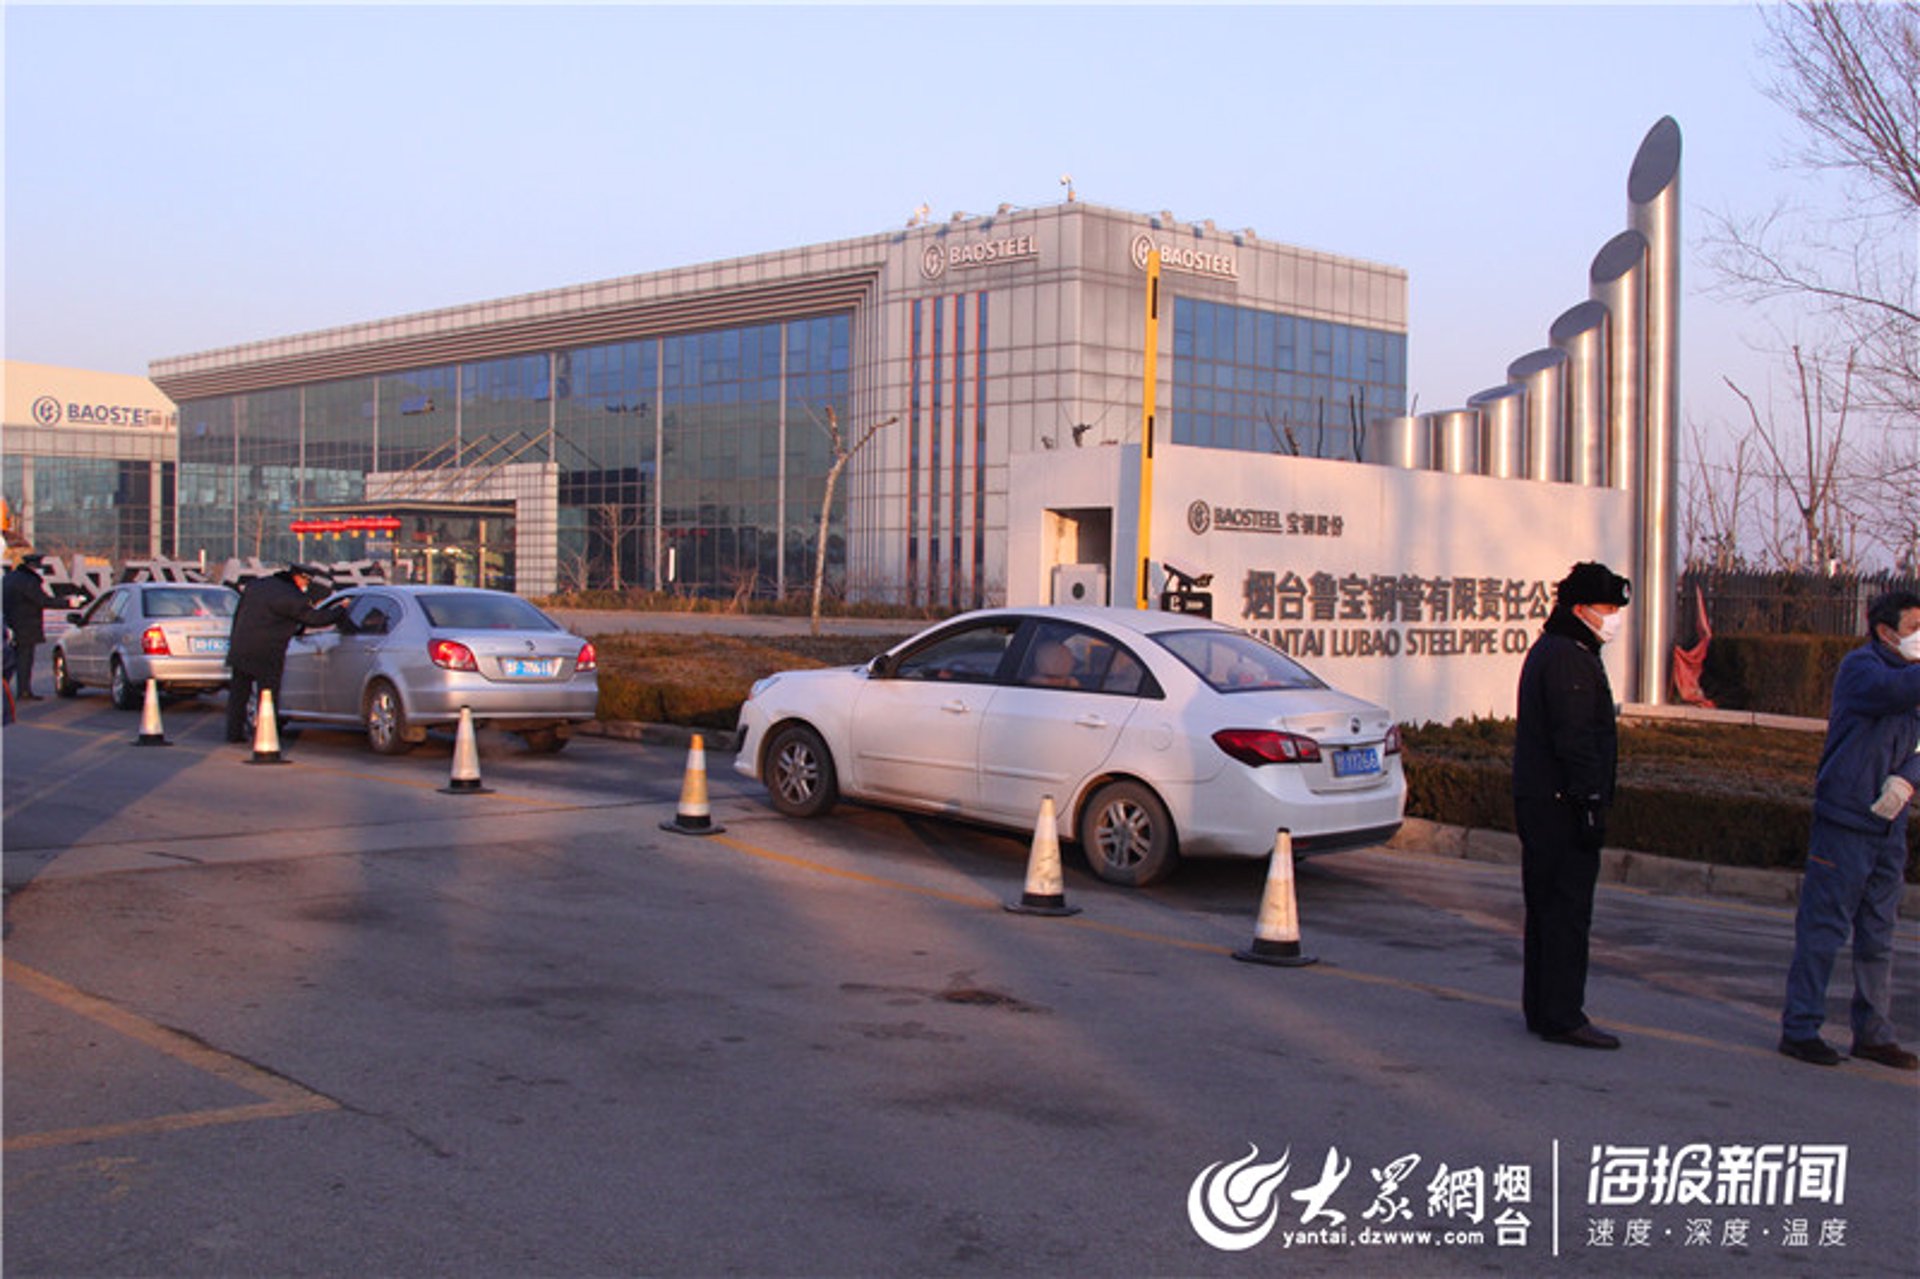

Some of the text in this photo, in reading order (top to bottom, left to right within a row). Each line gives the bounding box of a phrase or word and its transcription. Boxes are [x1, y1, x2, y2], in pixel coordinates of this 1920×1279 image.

[950, 234, 1038, 265] BAOSTEEL
[1160, 246, 1239, 276] BAOSTEEL
[1214, 507, 1282, 529] BAOSTEEL
[1250, 627, 1324, 657] ANTAI
[1330, 628, 1401, 657] LUBAO
[1406, 628, 1498, 655] STEELPIPE
